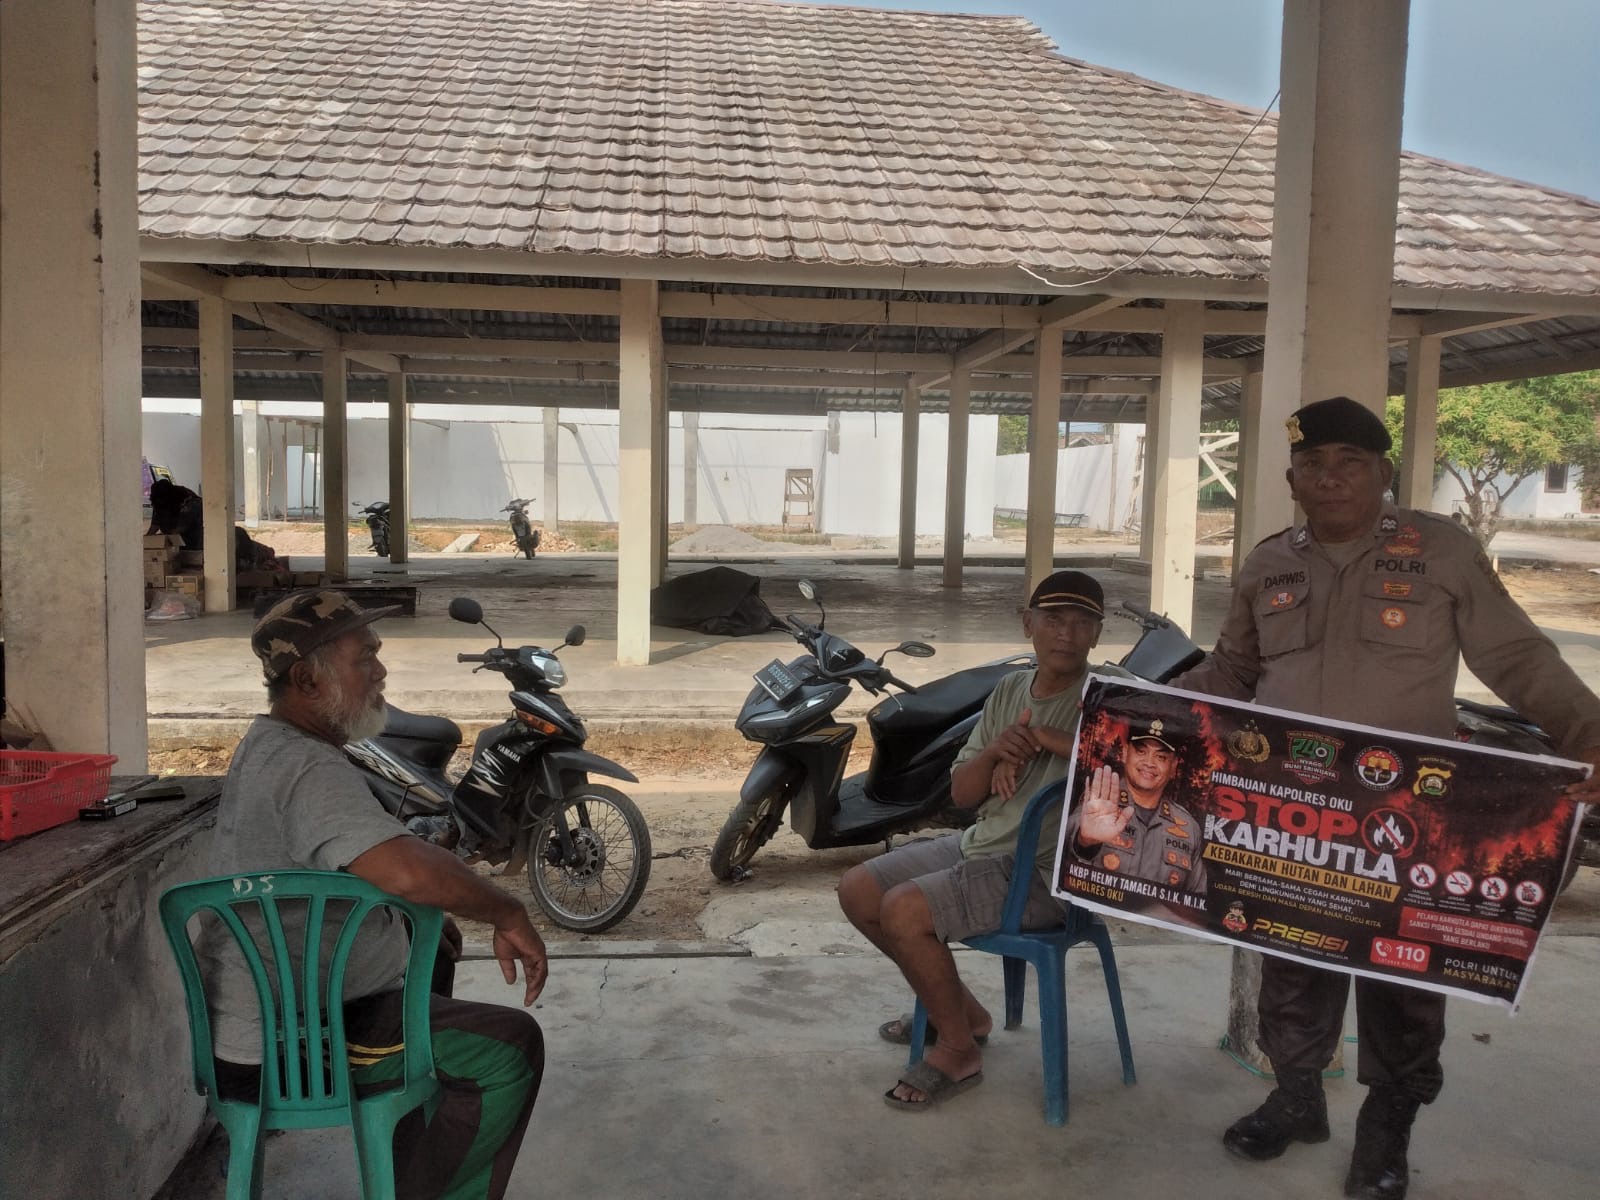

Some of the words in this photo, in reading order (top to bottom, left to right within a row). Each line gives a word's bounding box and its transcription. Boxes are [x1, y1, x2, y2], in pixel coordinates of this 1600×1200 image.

[1264, 571, 1306, 589] DARWIS
[1375, 559, 1426, 576] POLRI
[497, 744, 521, 764] YAMAHA
[1212, 771, 1266, 794] HIMBAUAN
[1270, 784, 1326, 806] KAPOLRES
[1330, 797, 1353, 812] OKU
[1215, 786, 1358, 842] STOP
[1166, 838, 1190, 852] POLRI
[1203, 814, 1398, 883] KARHUTLA
[1069, 864, 1089, 879] AKBP
[1091, 870, 1119, 887] HELMY
[1120, 876, 1157, 898] TAMAELA
[1159, 889, 1180, 904] S.I.K.
[1183, 894, 1207, 911] M.I.K.
[1210, 846, 1277, 872] KEBAKARAN
[1281, 863, 1320, 883] HUTAN
[1324, 874, 1349, 891] DAN
[1352, 879, 1392, 899] LAHAN
[1106, 888, 1124, 902] OKU
[1214, 882, 1237, 893] UDARA
[1238, 888, 1261, 899] BERSIH
[1262, 894, 1277, 904] DAN
[1278, 898, 1298, 908] MASA
[1299, 904, 1322, 913] DEPAN
[1323, 909, 1343, 919] ANAK
[1344, 914, 1364, 923] CUCU
[1225, 868, 1243, 878] MARI
[1244, 872, 1301, 892] BERSAMA-SAMA
[1303, 887, 1329, 898] CEGAH
[1330, 894, 1370, 908] KARHUTLA
[1239, 881, 1256, 890] DEMI
[1258, 885, 1306, 901] LINGKUNGAN
[1307, 897, 1327, 907] YANG
[1252, 918, 1349, 952] PRESISI
[1396, 946, 1425, 962] 110
[1445, 958, 1478, 971] POLRI
